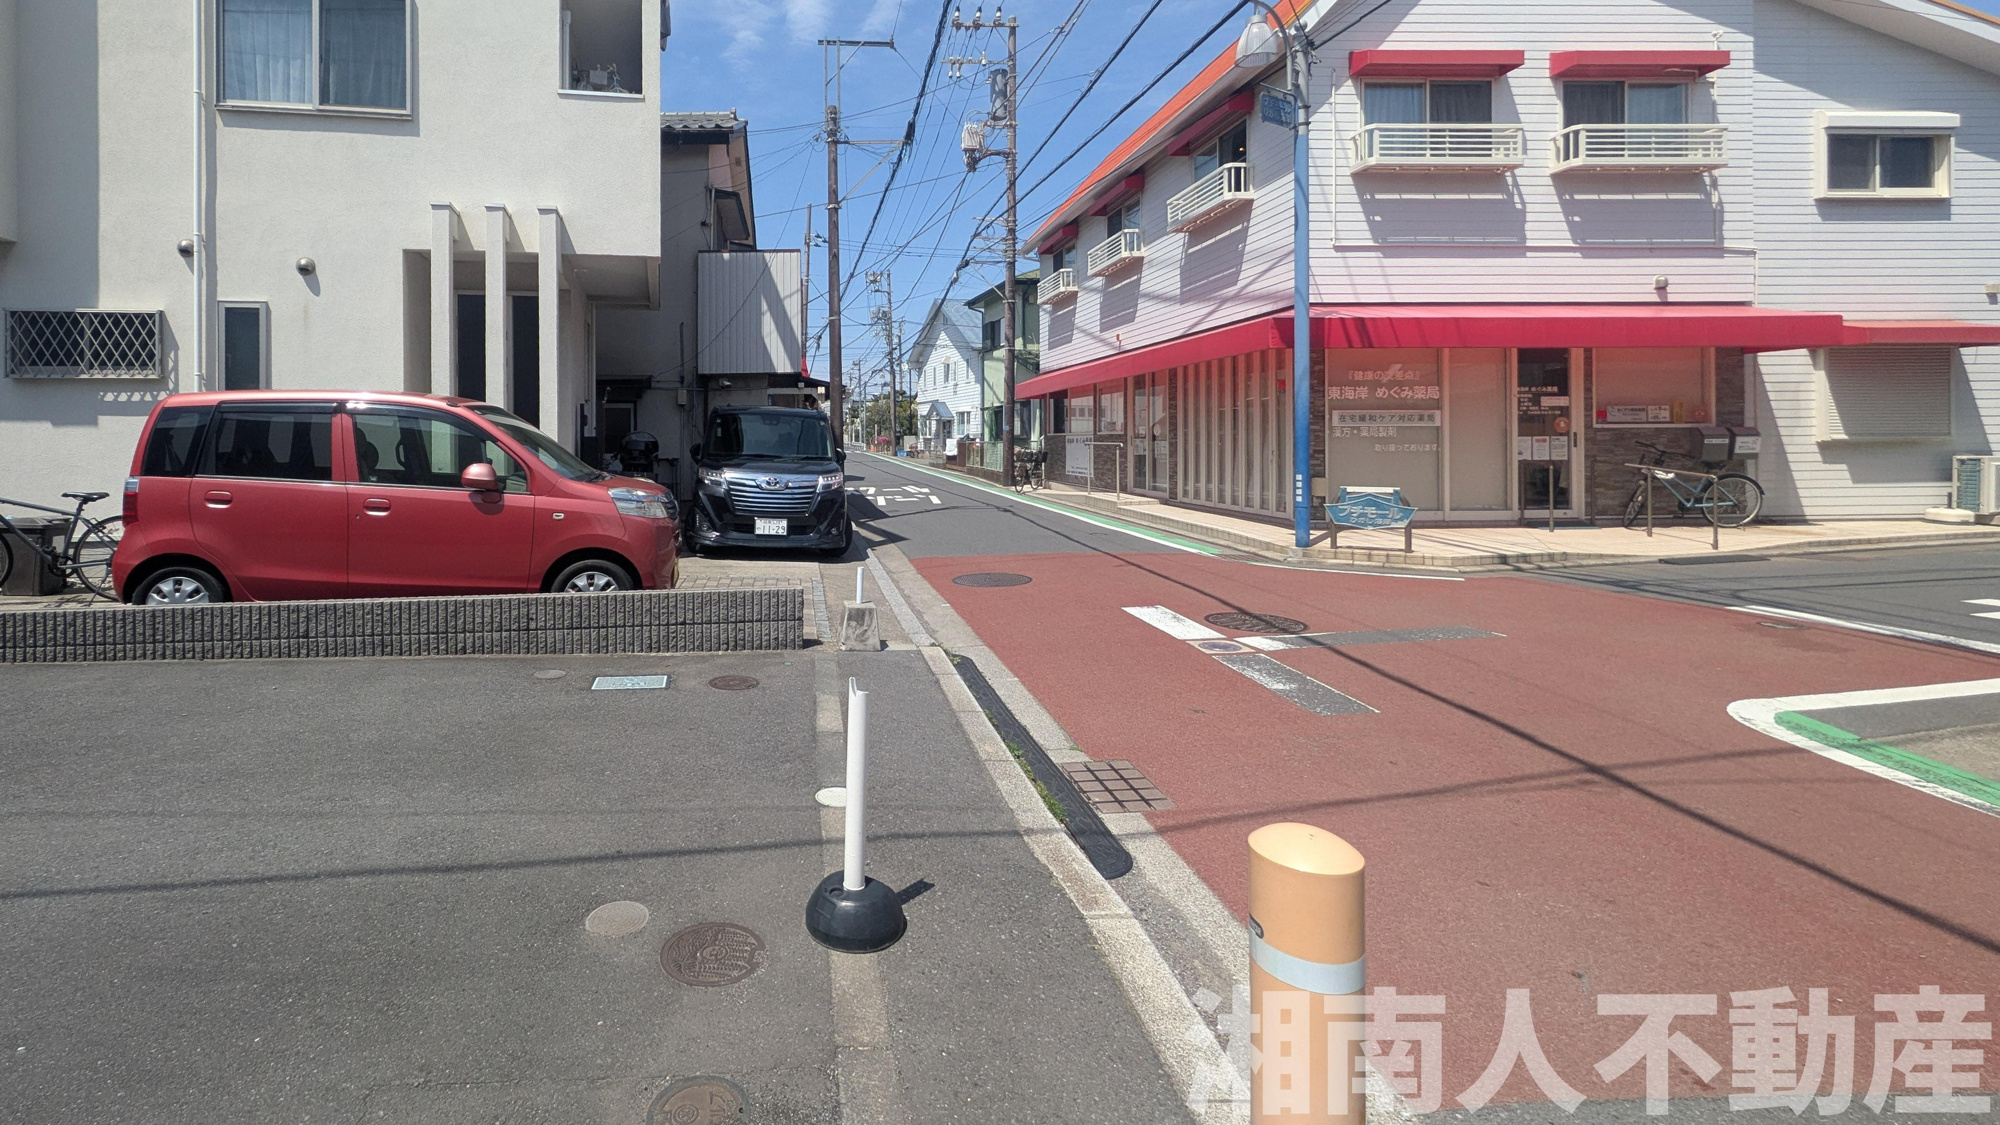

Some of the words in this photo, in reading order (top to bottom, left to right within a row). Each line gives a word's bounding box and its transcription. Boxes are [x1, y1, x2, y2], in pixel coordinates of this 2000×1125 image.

[1328, 386, 1368, 399] 東海岸
[1375, 386, 1440, 399] めぐみ薬局
[1332, 426, 1397, 438] 漢方・薬局製剤
